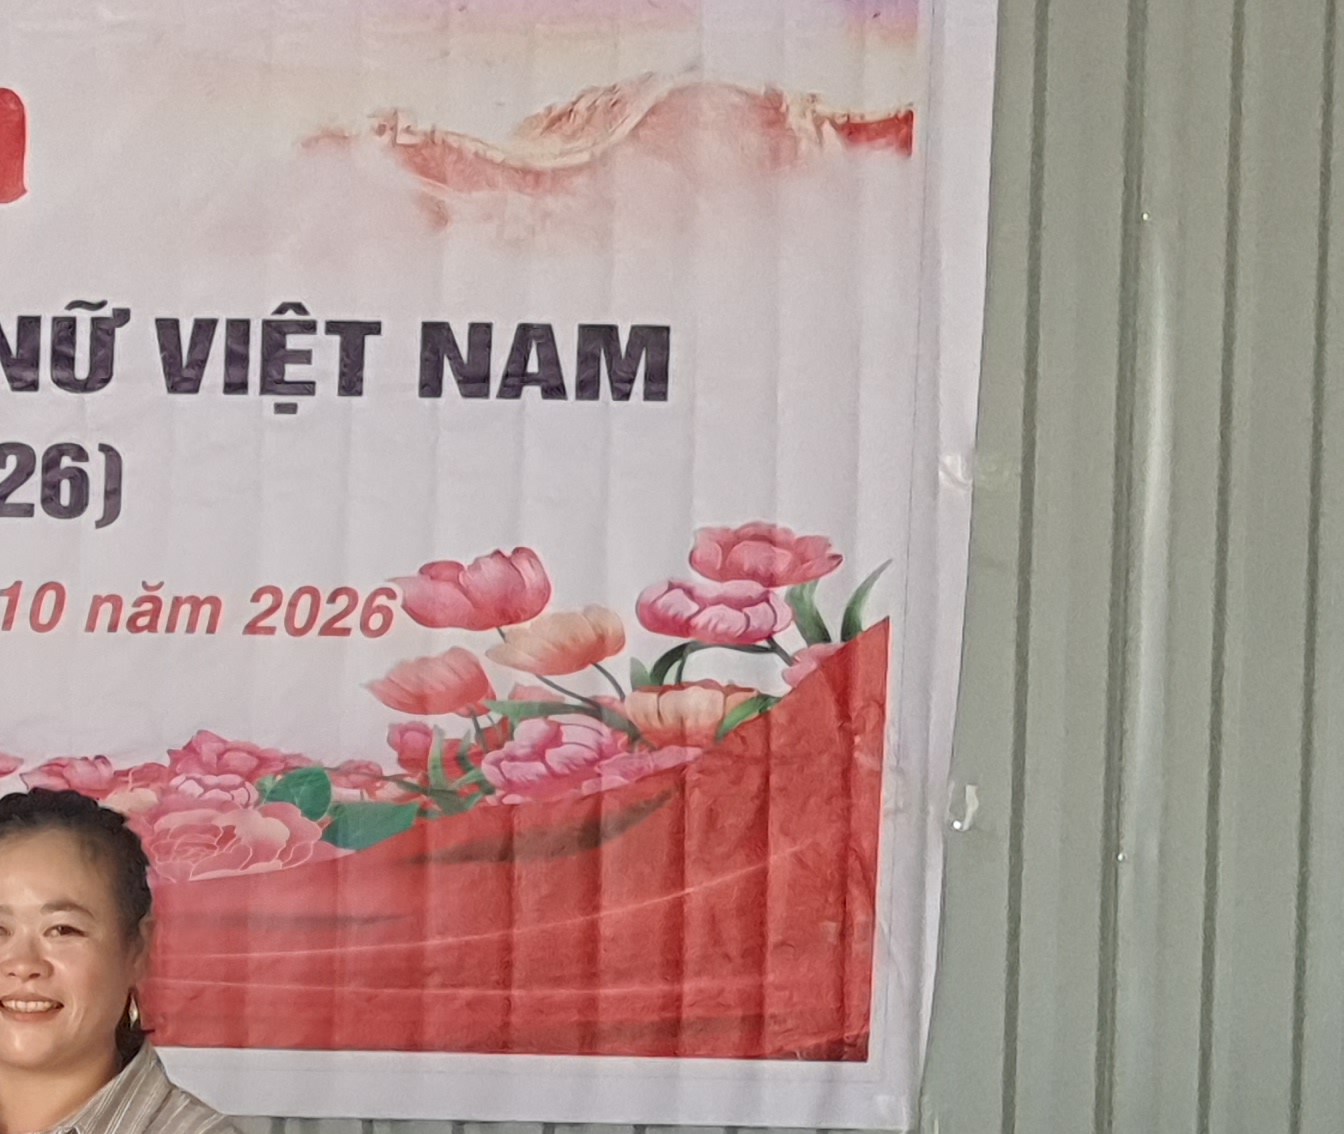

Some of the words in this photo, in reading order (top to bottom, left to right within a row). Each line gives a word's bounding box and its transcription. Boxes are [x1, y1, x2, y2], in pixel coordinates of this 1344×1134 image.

[153, 301, 383, 415] VIỆT
[417, 321, 672, 403] NAM
[84, 584, 224, 635] năm
[243, 585, 396, 639] 2026
